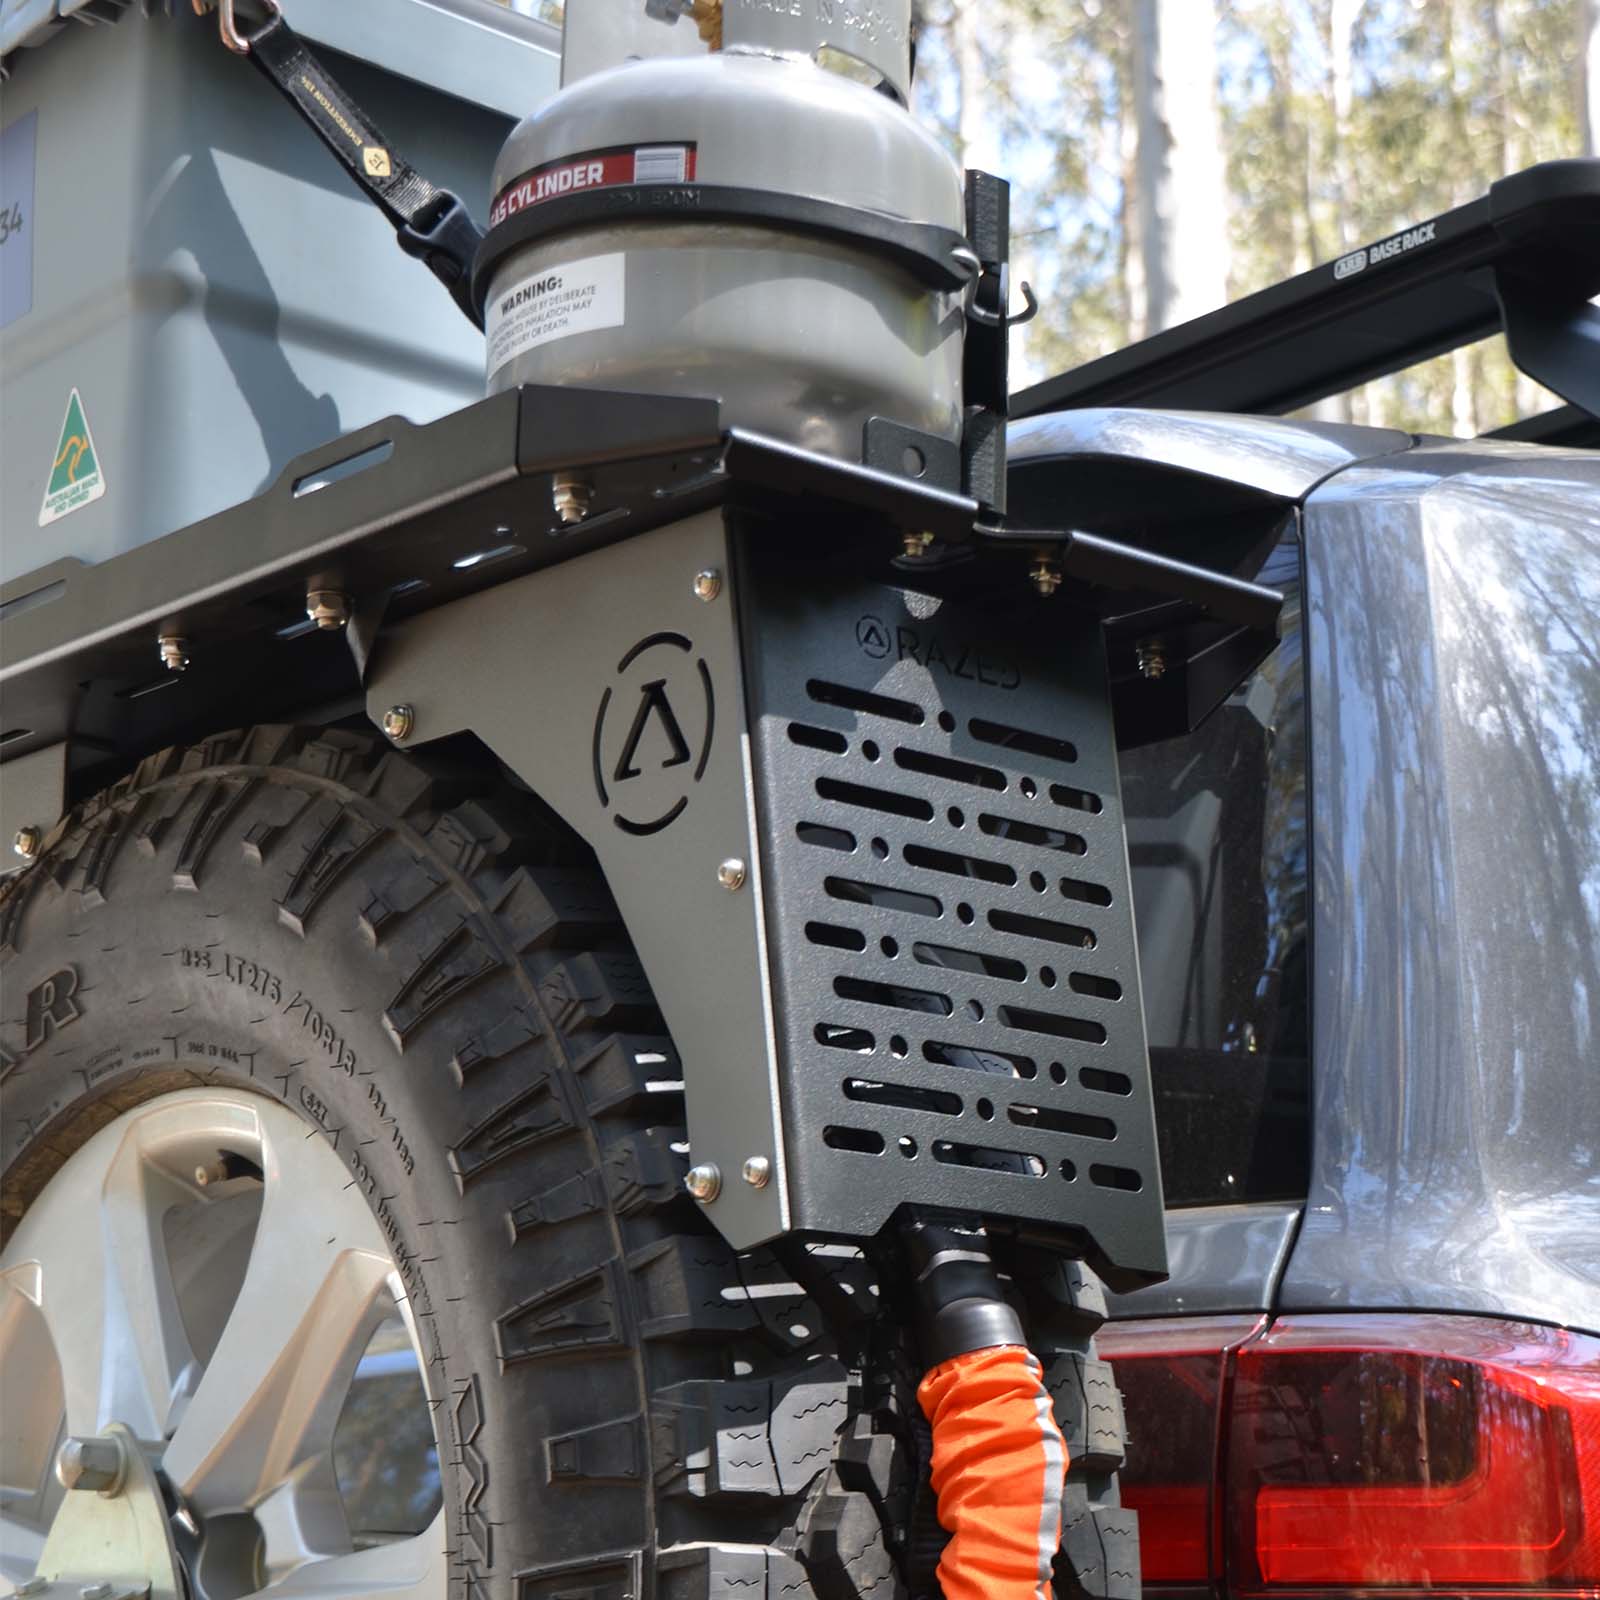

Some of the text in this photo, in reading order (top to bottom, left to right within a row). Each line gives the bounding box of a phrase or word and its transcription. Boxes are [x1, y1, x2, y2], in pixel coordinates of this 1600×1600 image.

[508, 162, 604, 214] CYLINDER
[1370, 238, 1402, 264] BASE
[1403, 222, 1436, 250] RACK
[501, 276, 563, 316] WARNING:
[572, 299, 593, 311] MAY
